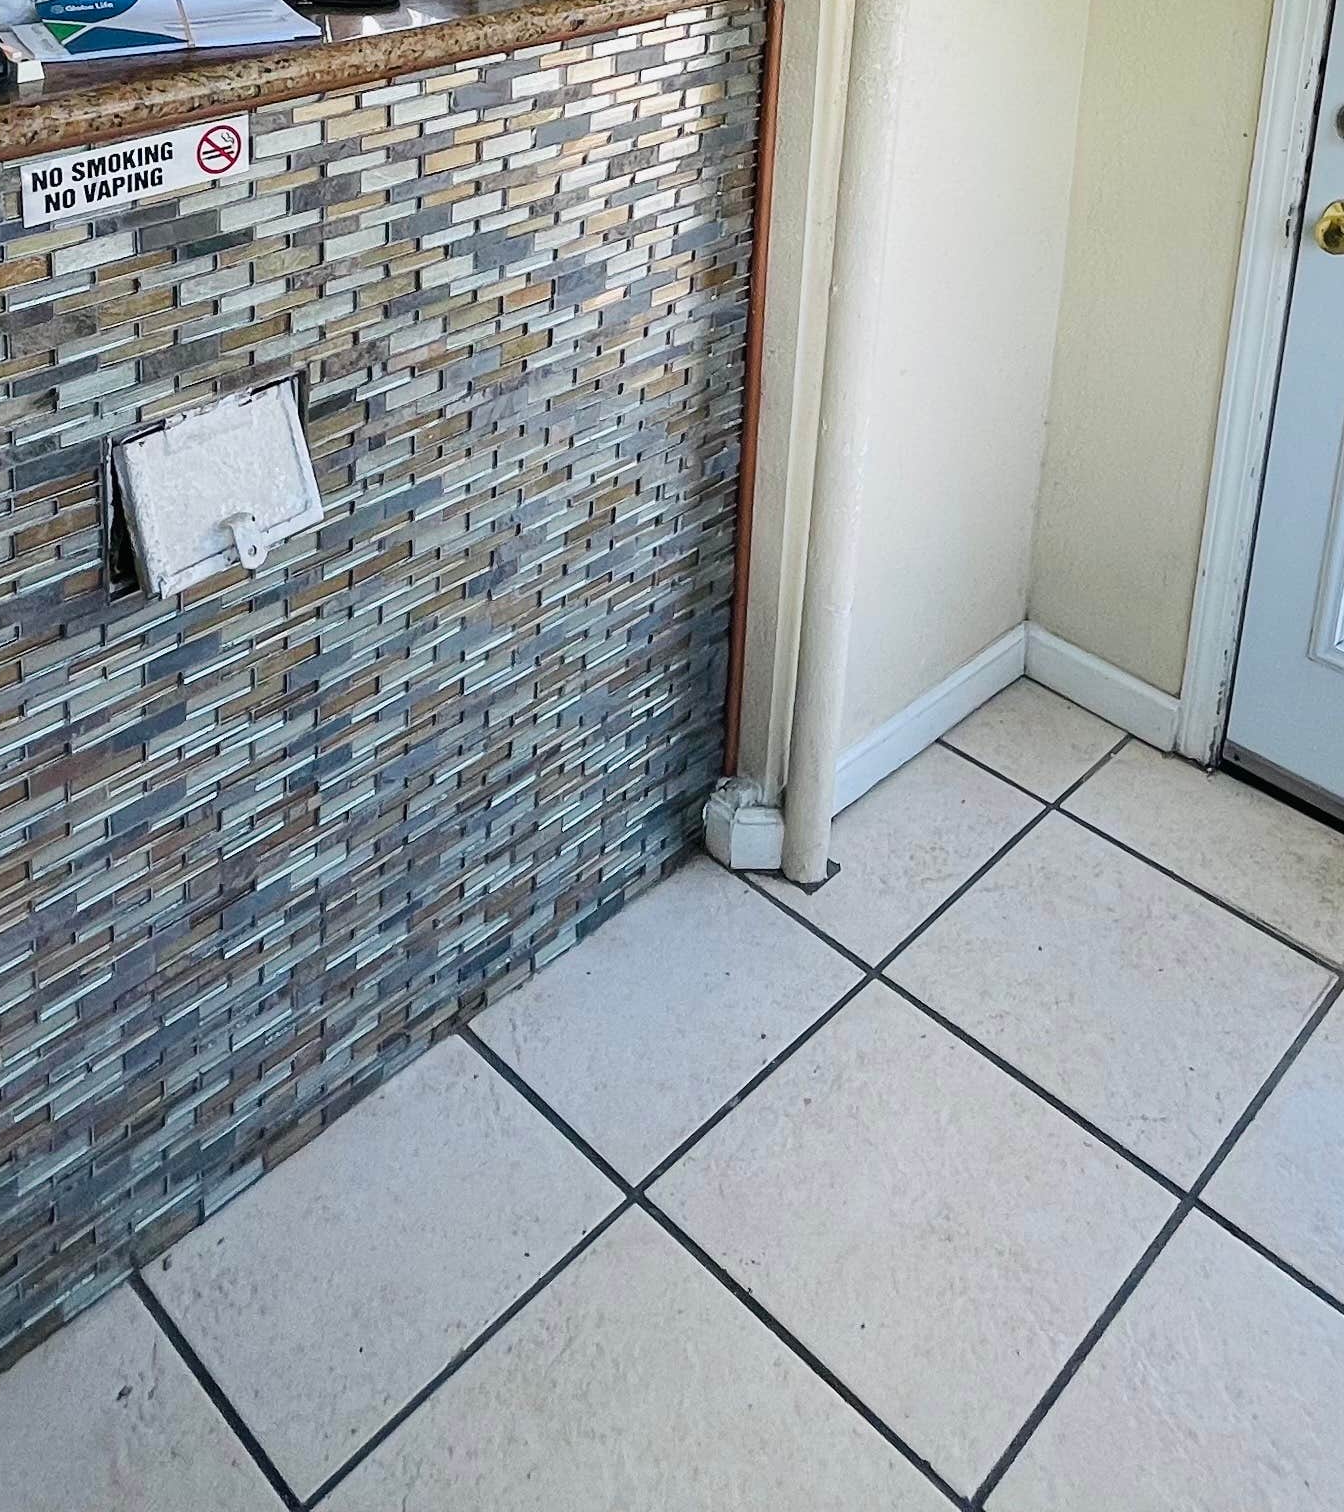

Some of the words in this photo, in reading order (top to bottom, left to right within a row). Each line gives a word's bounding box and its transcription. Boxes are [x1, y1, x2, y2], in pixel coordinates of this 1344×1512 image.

[94, 1, 114, 10] Life
[31, 163, 64, 192] NO
[71, 141, 174, 183] SMOKING
[43, 186, 77, 214] NO
[82, 167, 164, 207] VAPING
